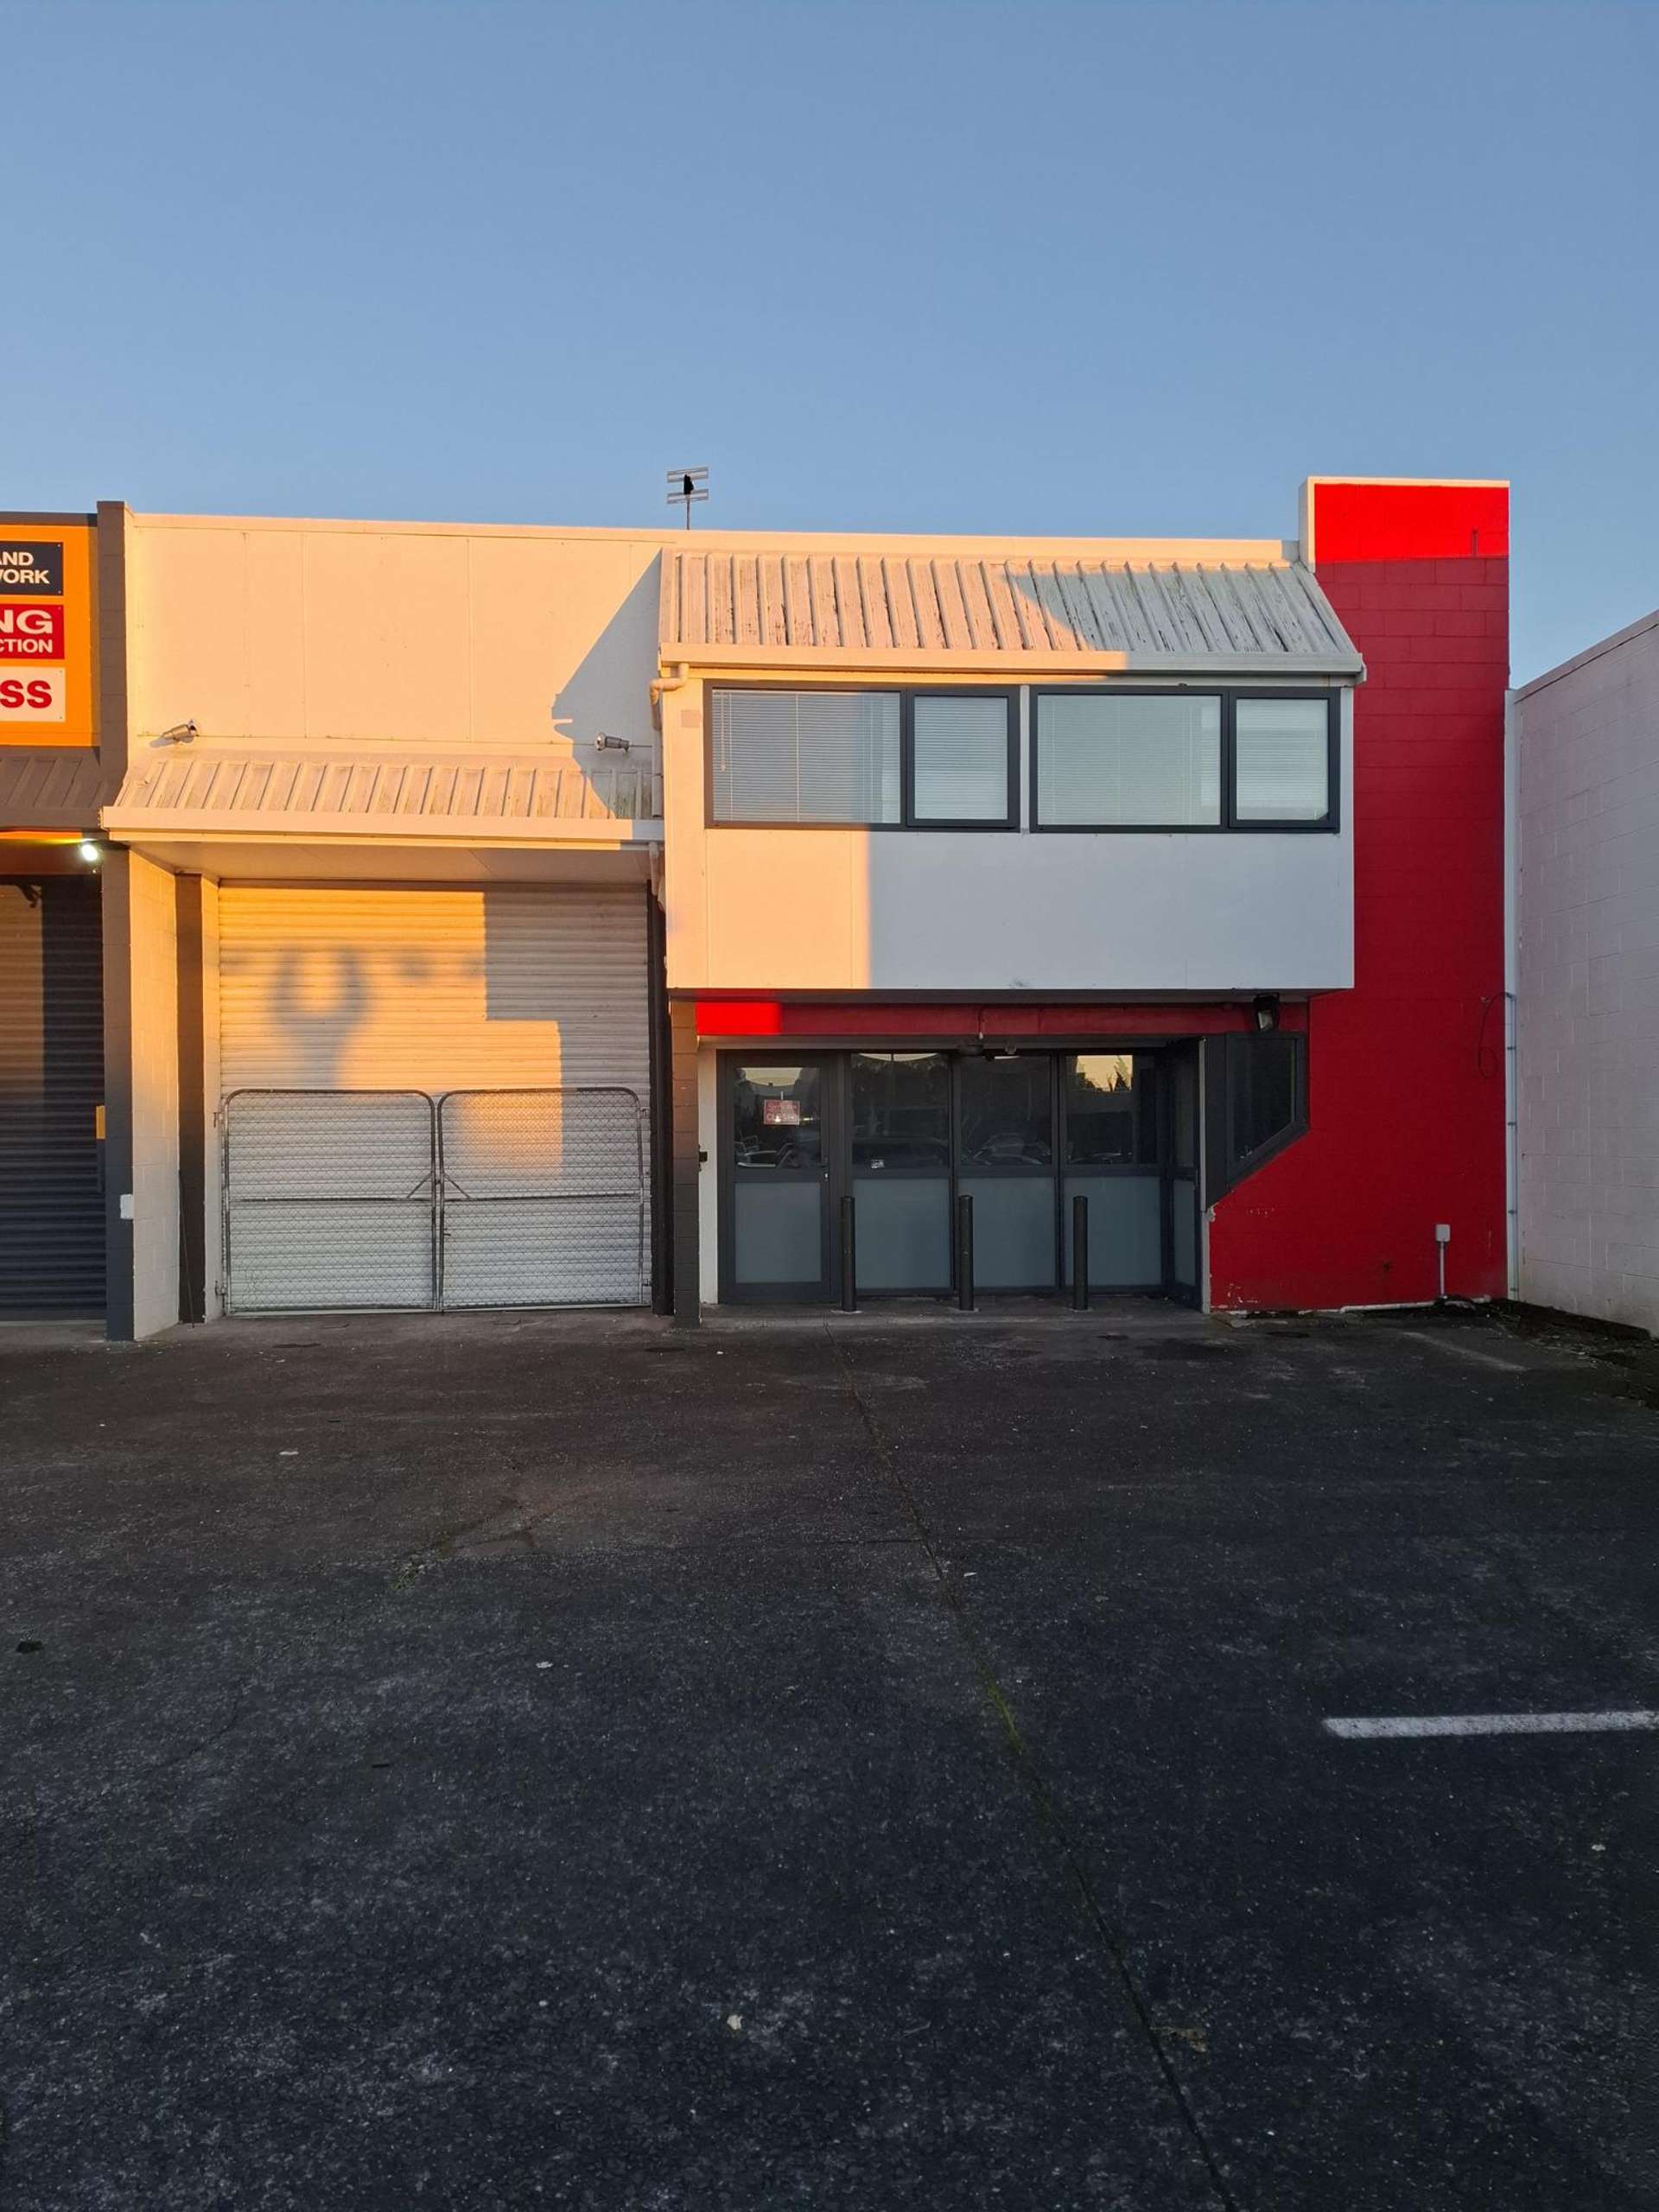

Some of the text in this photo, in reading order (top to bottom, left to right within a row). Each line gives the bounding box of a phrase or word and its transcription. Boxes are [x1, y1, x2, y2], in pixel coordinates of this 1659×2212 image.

[0, 551, 34, 565] ND
[0, 569, 50, 583] ORK
[0, 679, 52, 709] SS
